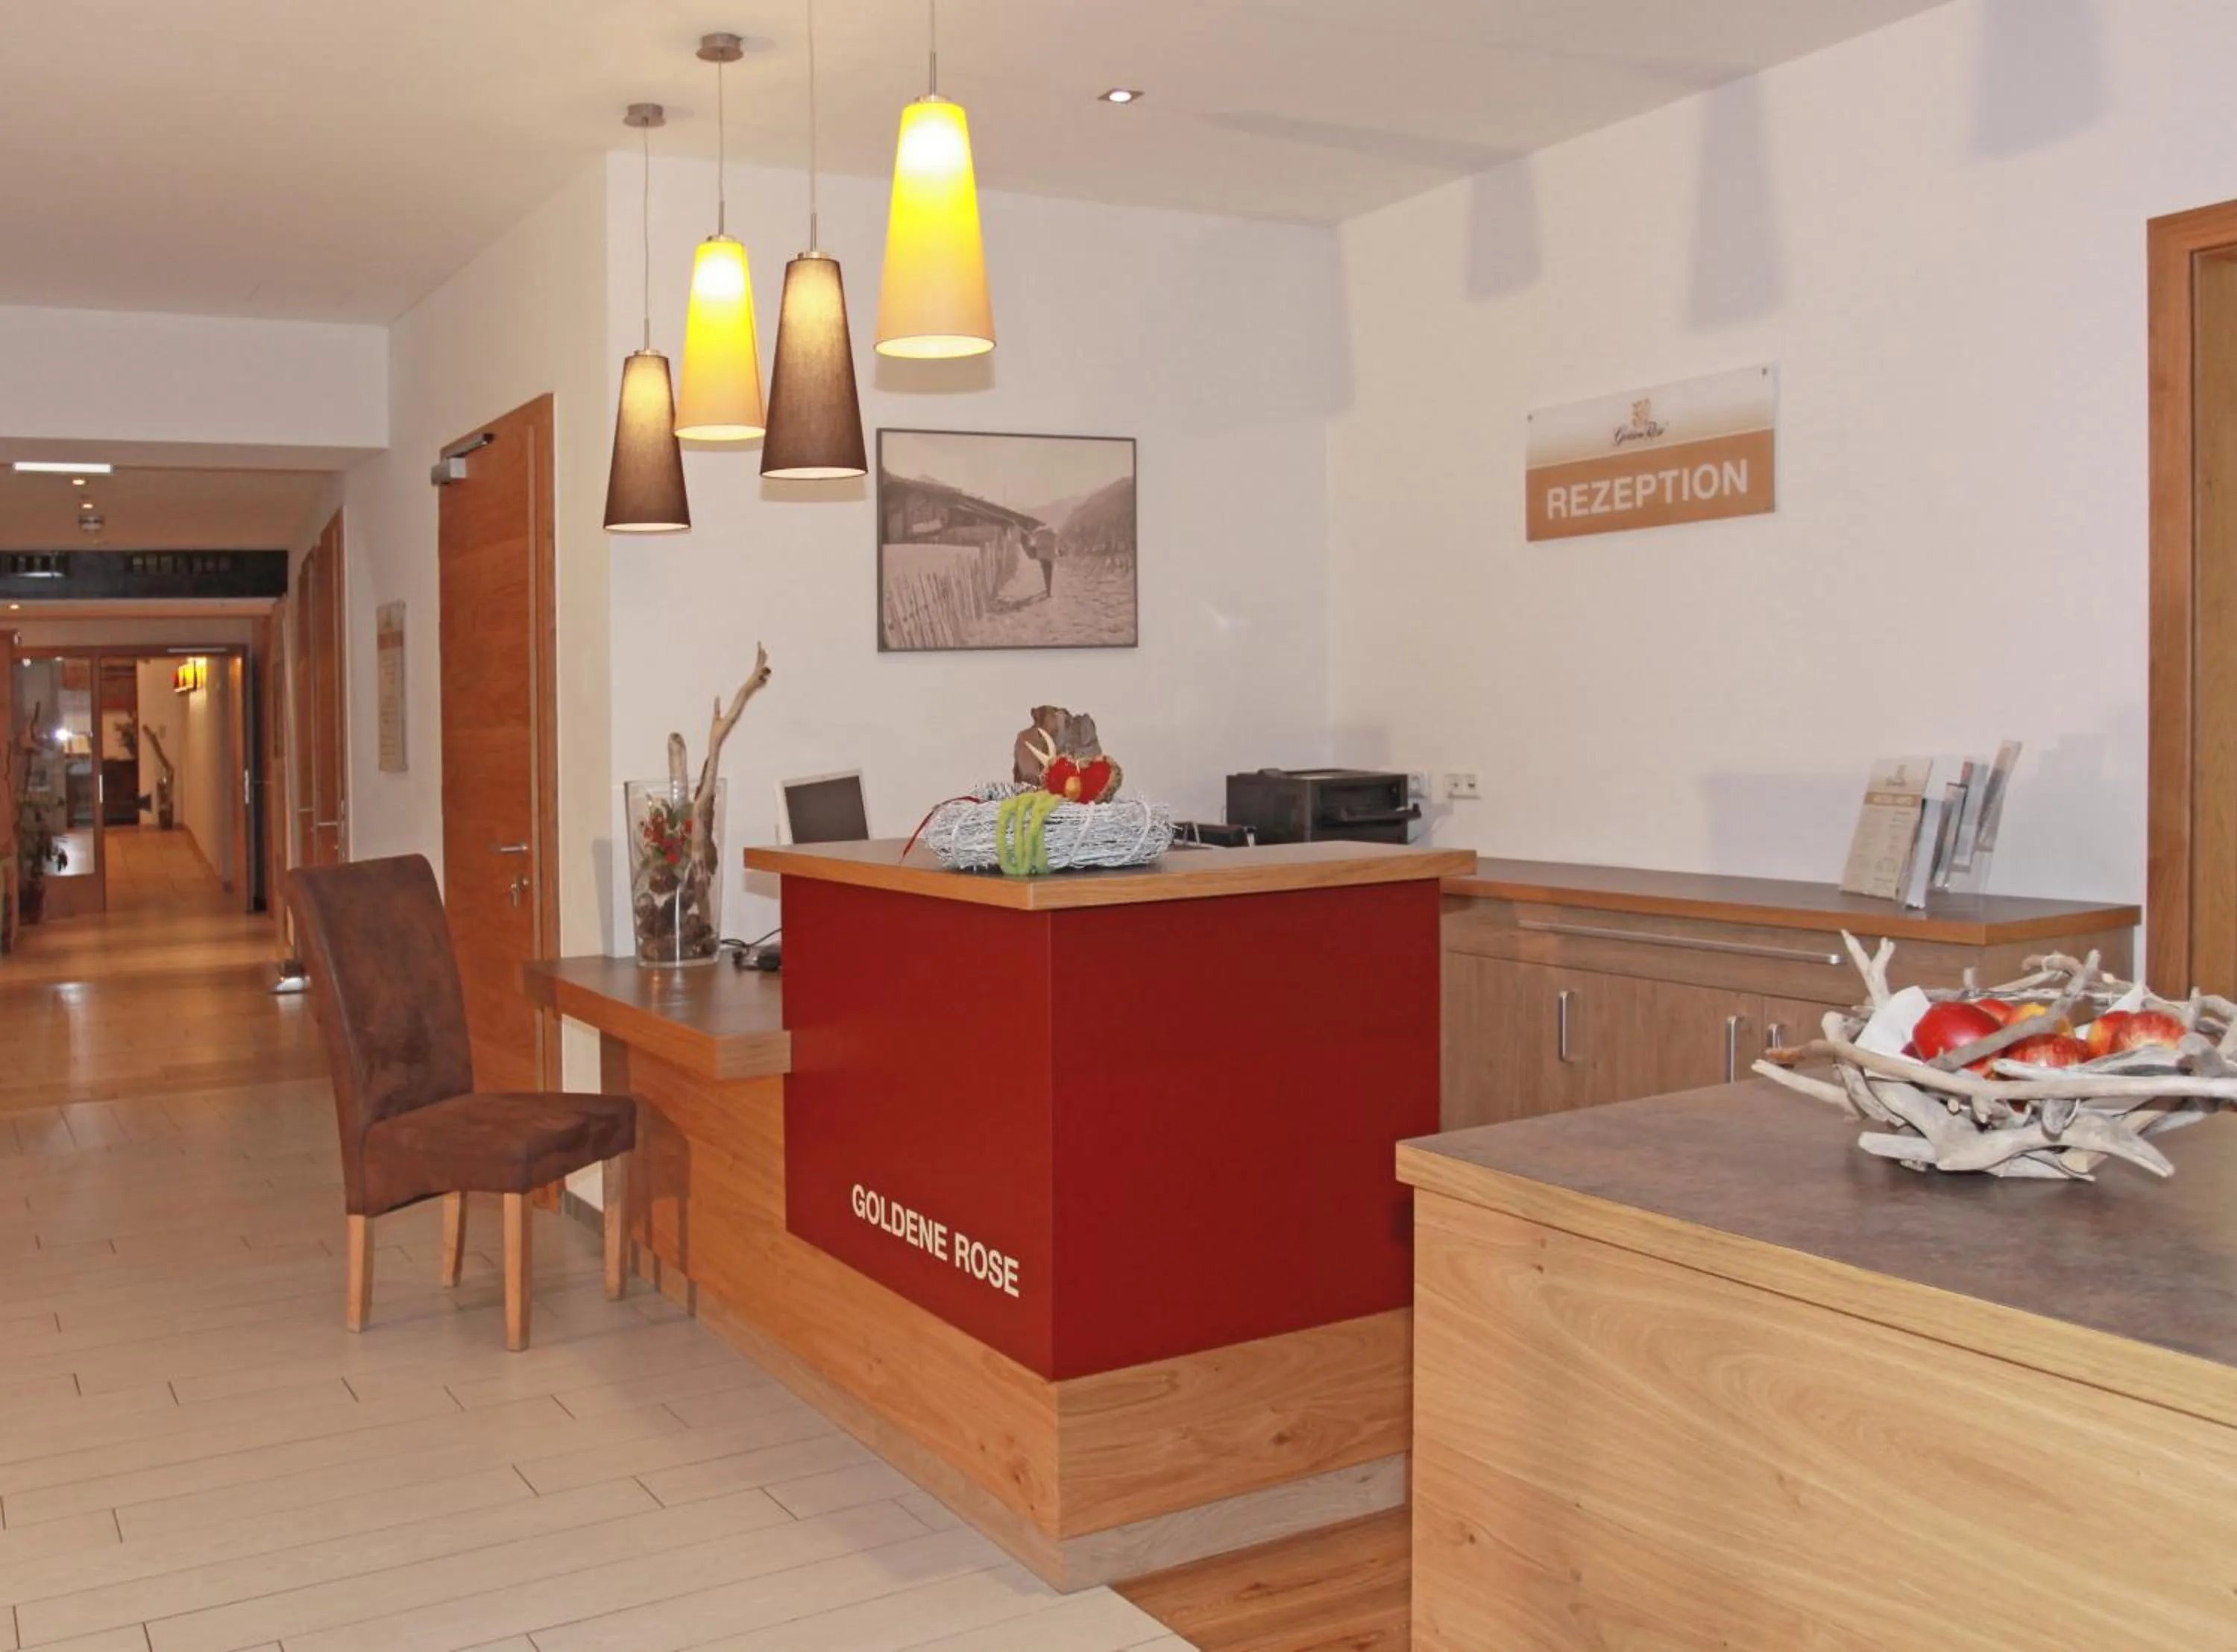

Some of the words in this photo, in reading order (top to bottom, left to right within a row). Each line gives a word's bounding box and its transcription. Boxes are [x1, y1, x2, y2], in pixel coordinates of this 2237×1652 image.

[1546, 458, 1748, 520] REZEPTION
[852, 1184, 948, 1261] GOLDENE
[954, 1232, 1019, 1296] ROSE
